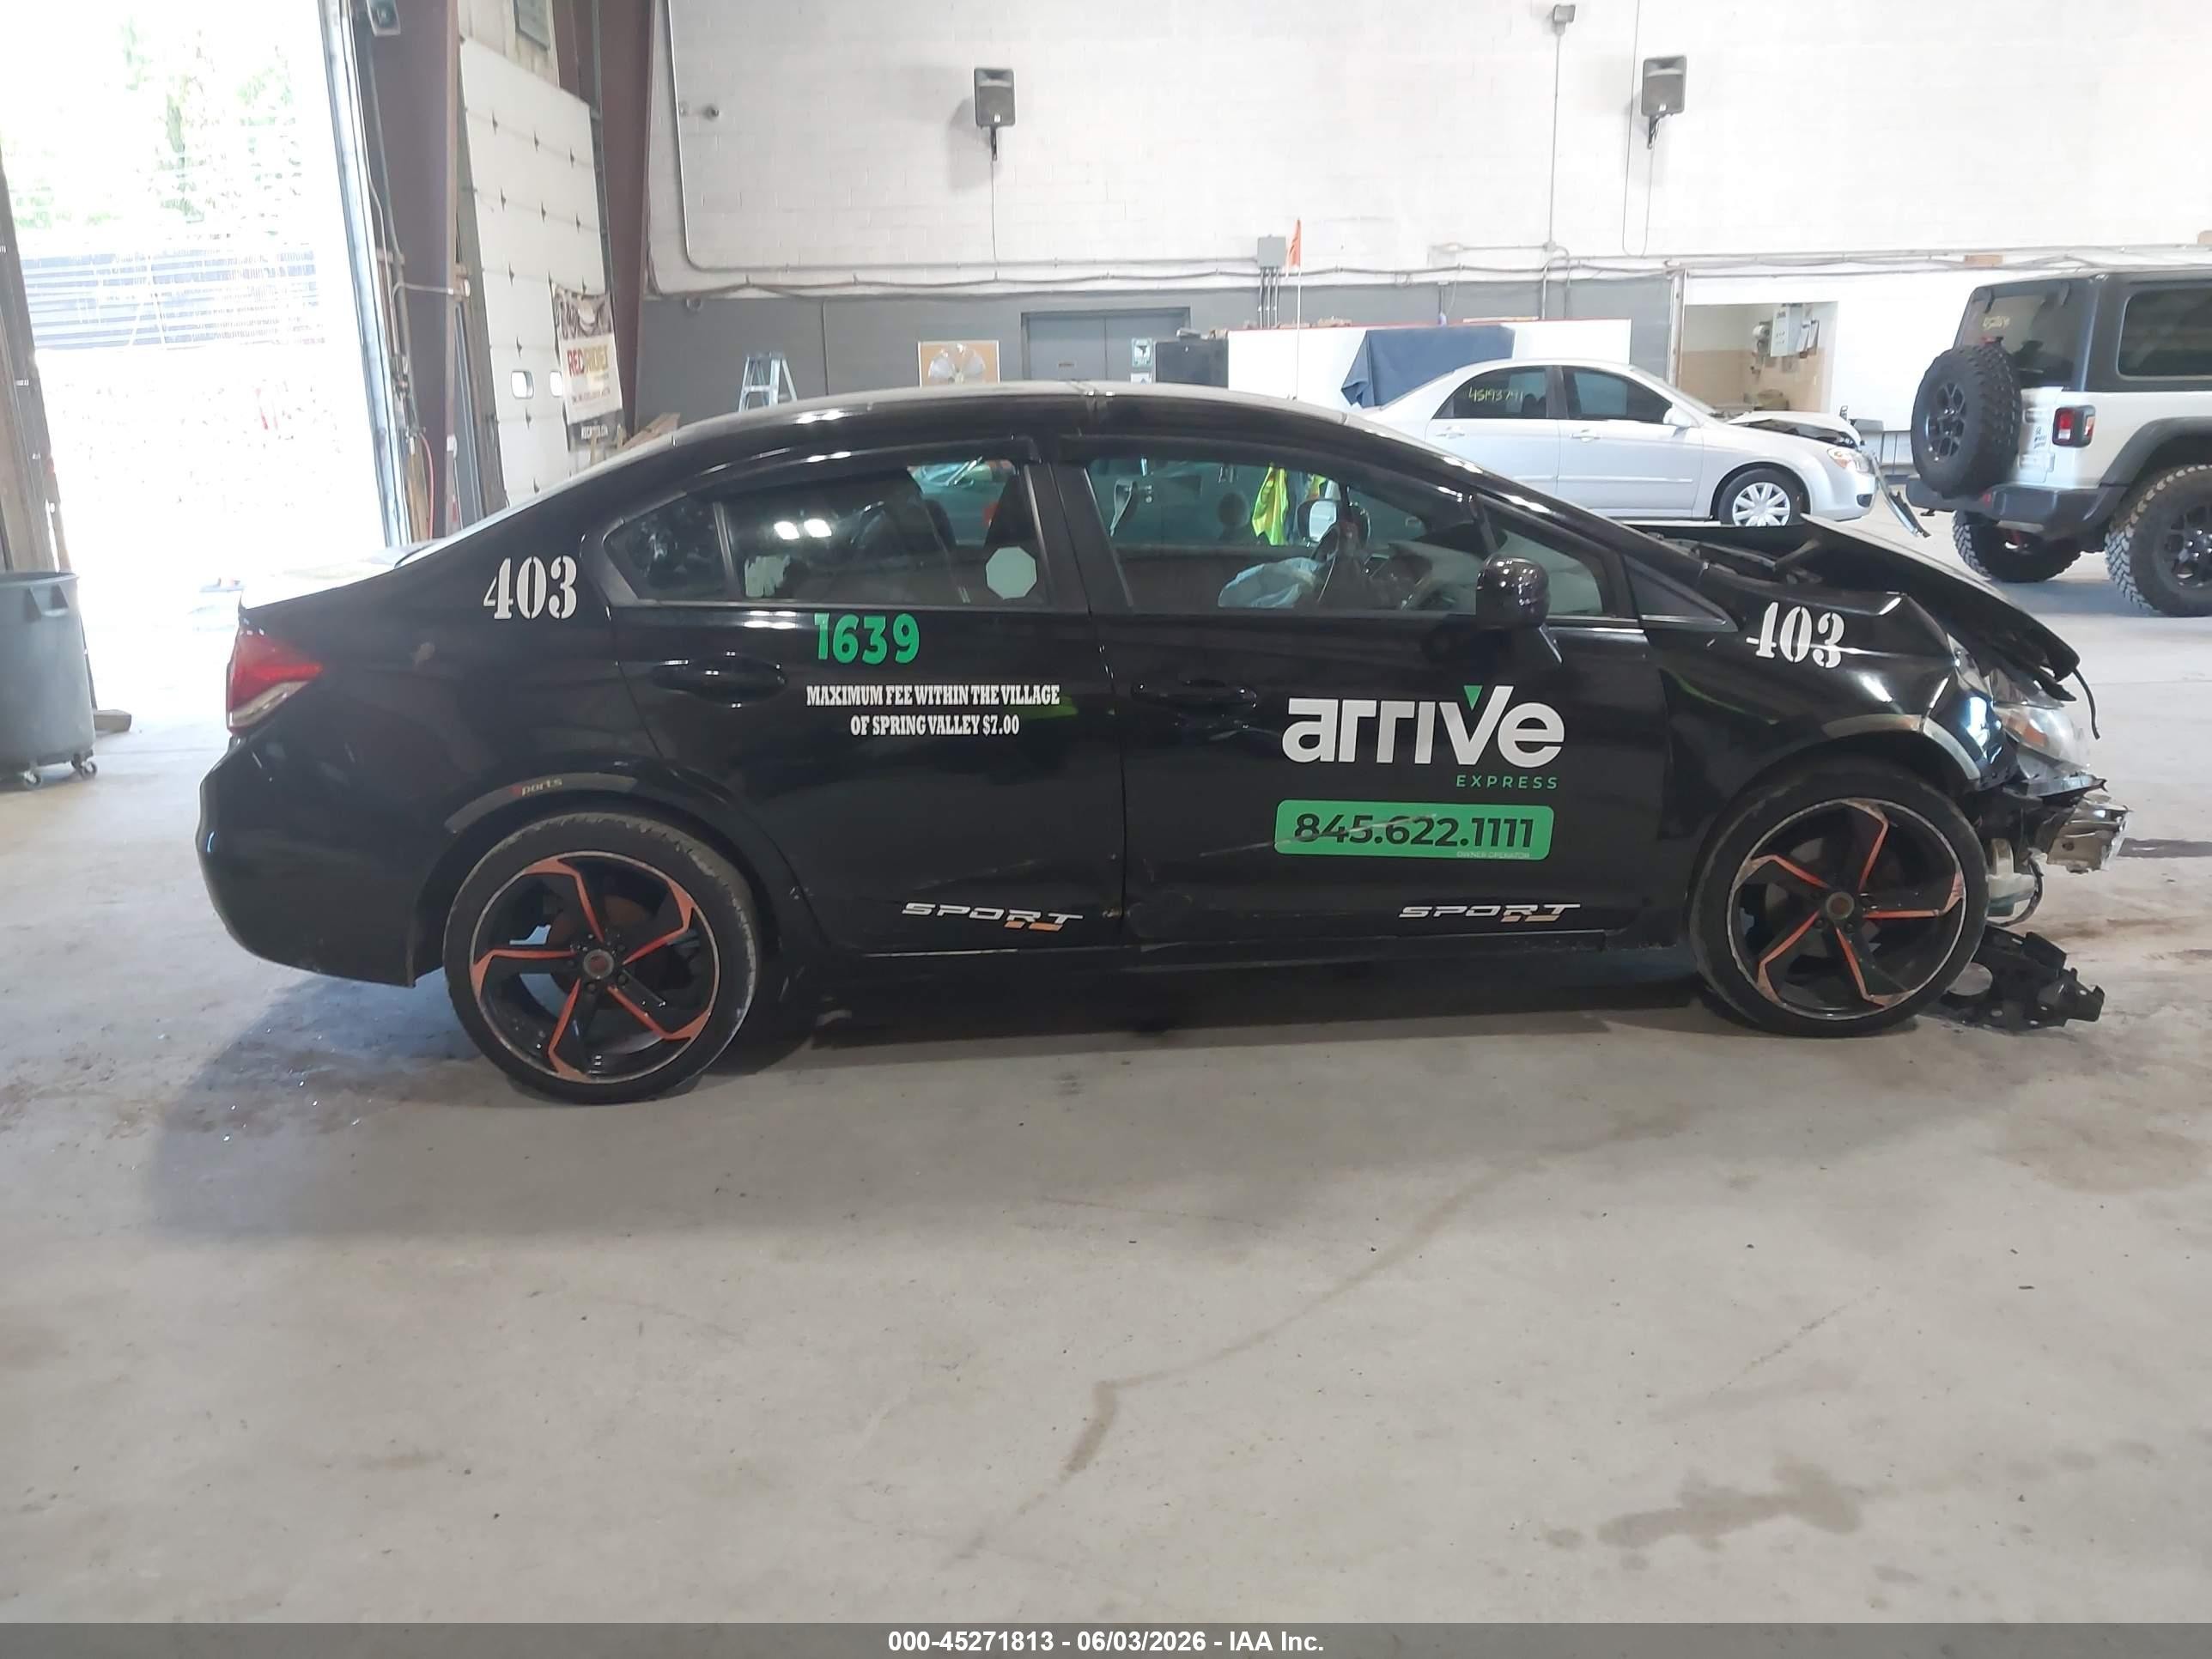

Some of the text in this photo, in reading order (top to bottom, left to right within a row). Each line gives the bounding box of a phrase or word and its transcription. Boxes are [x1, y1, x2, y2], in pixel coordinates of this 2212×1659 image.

[483, 555, 577, 619] 403
[814, 612, 920, 665] 1639
[1746, 601, 1845, 669] 403
[806, 684, 1060, 706] MAXIMUM FEE WITHIN THE VILLAGE
[850, 714, 1020, 737] OF SPRING VALLEY $7.00
[1455, 775, 1558, 789] EXPRESS
[1294, 813, 1534, 848] 845.622.1111
[902, 902, 1084, 930] SPORT
[1399, 904, 1581, 922] SPORT
